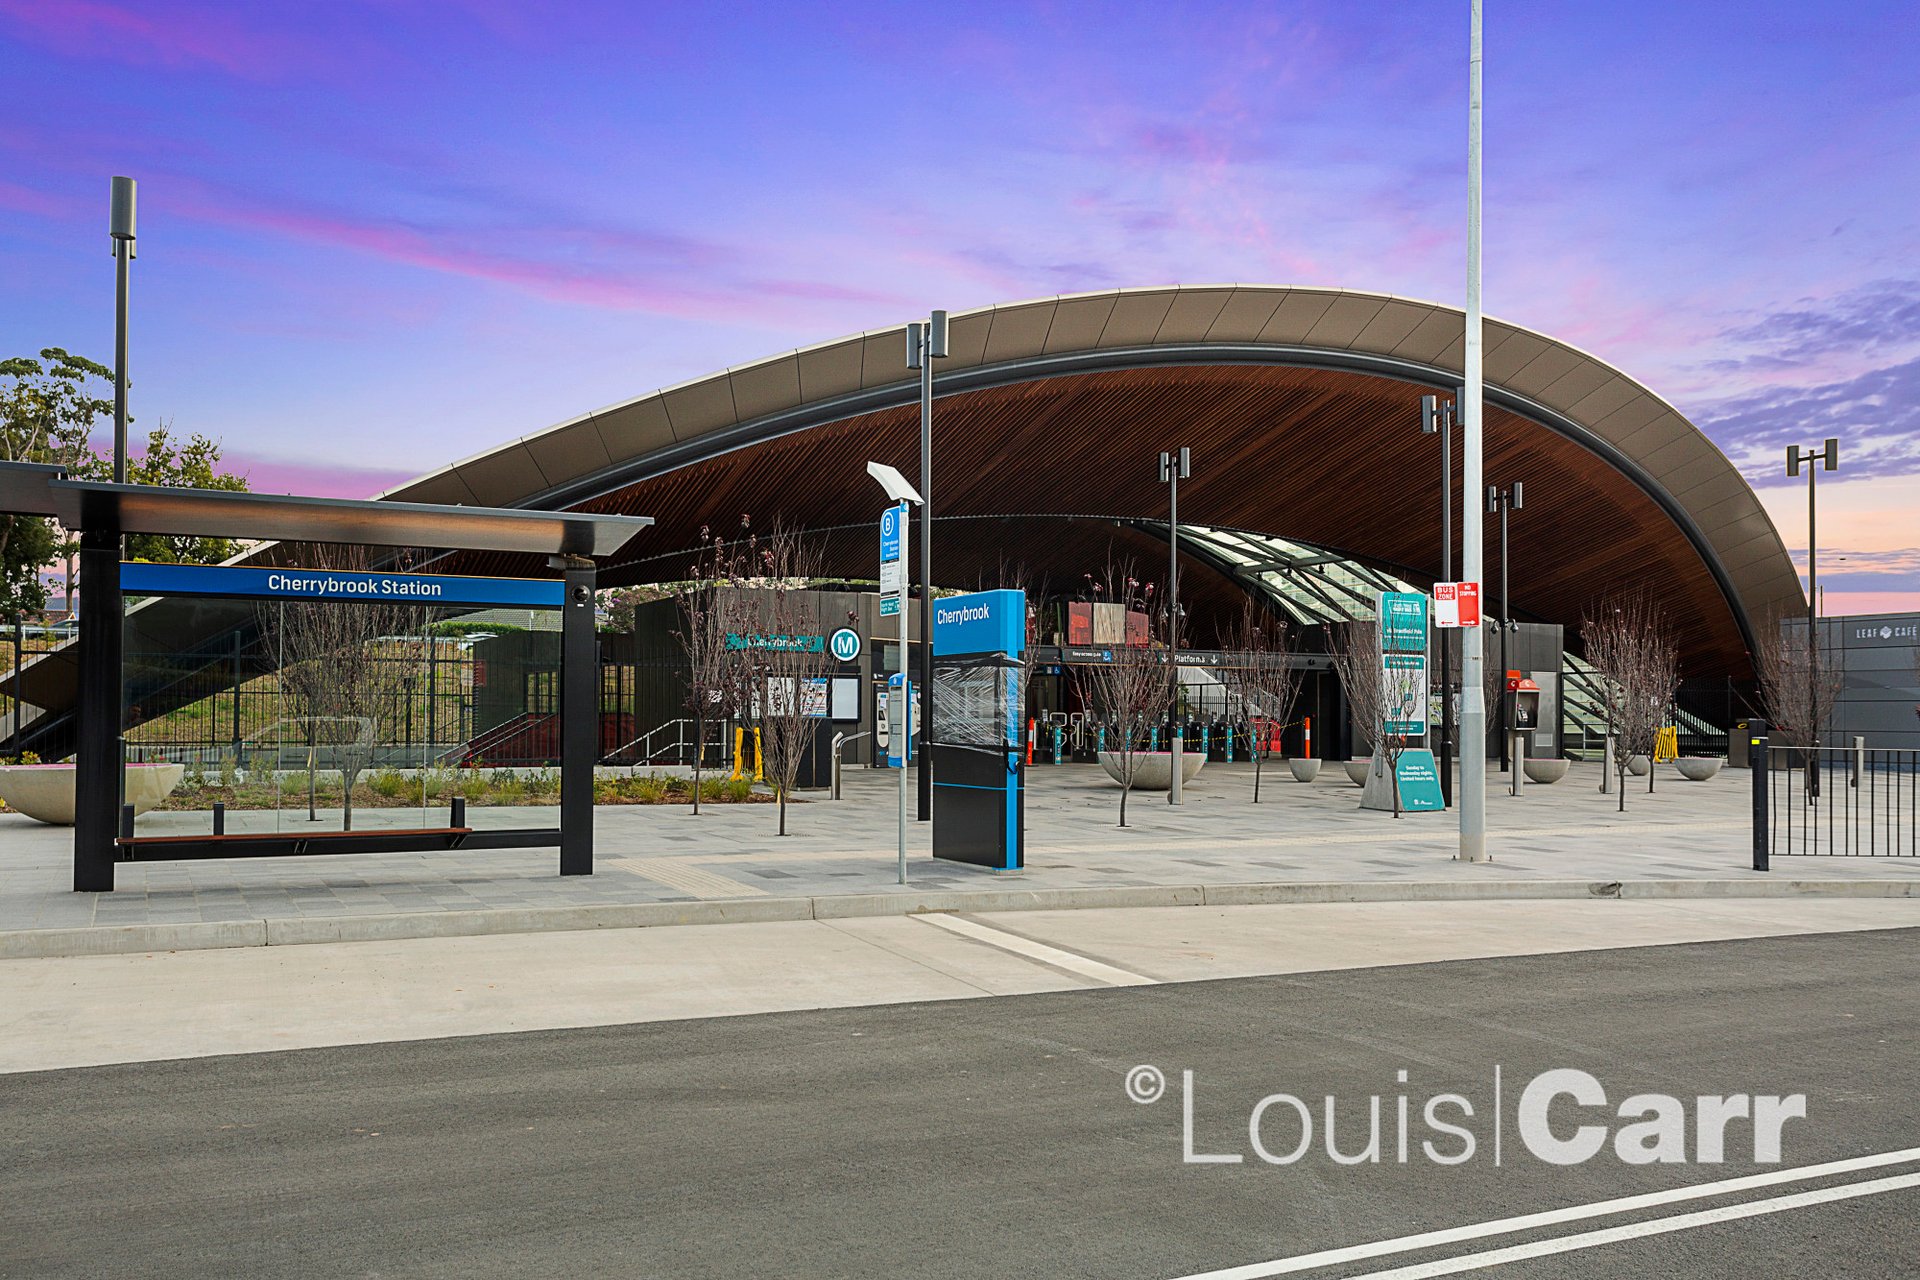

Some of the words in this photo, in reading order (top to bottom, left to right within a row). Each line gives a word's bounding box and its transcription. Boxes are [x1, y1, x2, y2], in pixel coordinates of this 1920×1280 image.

[885, 517, 891, 531] B
[268, 575, 378, 595] Cherrybrook
[381, 579, 442, 596] Station
[937, 603, 990, 626] Cherrybrook
[1856, 628, 1877, 638] LEAF
[837, 636, 854, 655] M
[1174, 654, 1206, 663] Platforms
